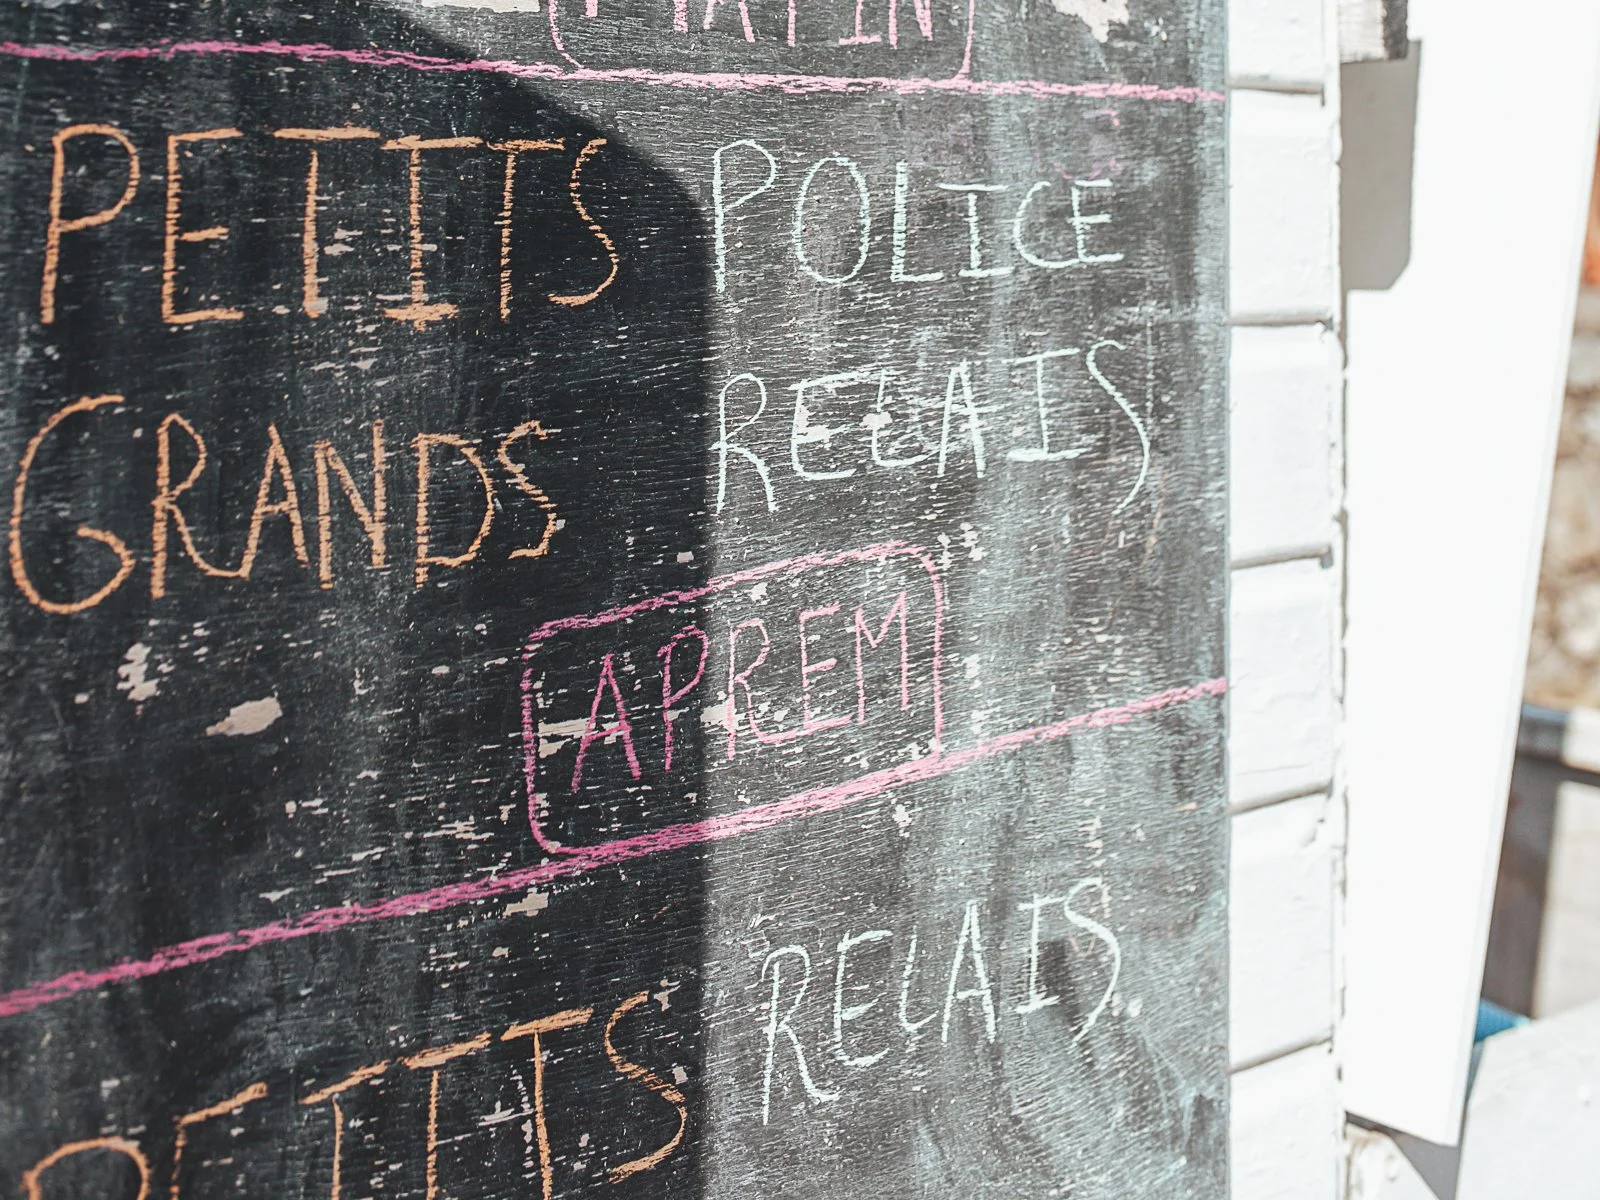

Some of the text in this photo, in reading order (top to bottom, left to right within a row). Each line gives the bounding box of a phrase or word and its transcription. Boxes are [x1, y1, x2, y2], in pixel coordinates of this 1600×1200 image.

[40, 123, 619, 332] PETITS
[712, 138, 1124, 293] POLICE
[9, 393, 560, 616] GRANDS
[711, 339, 1152, 514] RELAIS
[571, 591, 911, 792] APREM
[761, 876, 1121, 1127] RELAIS
